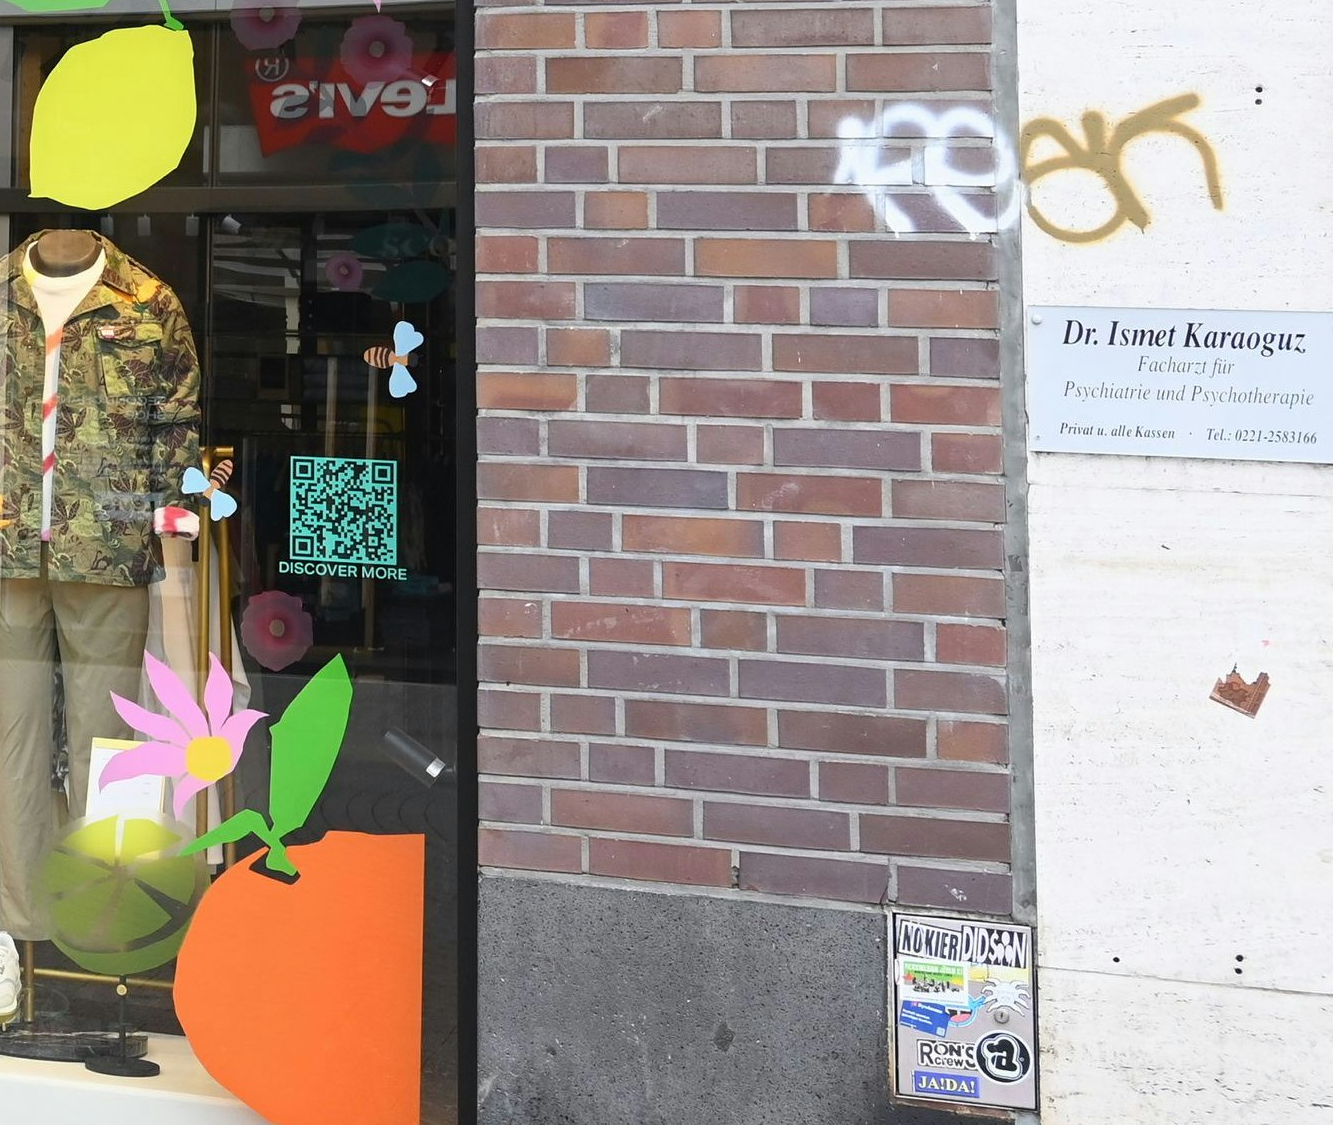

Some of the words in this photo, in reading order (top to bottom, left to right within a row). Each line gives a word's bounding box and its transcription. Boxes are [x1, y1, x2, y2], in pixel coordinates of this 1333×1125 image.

[1062, 319, 1099, 346] Dr.
[1107, 320, 1176, 348] Ismet
[1183, 322, 1307, 358] Karaoguz
[1137, 356, 1207, 375] Facharzt
[1209, 358, 1235, 378] für
[1063, 381, 1151, 403] Psychiatrie
[1156, 385, 1185, 403] und
[1191, 386, 1315, 410] Psychotherapie
[1059, 422, 1094, 437] Privat
[1097, 426, 1108, 437] u.
[1111, 424, 1132, 438] alle
[1135, 426, 1176, 440] Kassen
[1234, 428, 1318, 444] 0221-2583166
[279, 561, 358, 578] DISCOVER
[361, 565, 408, 581] MORE
[934, 1055, 963, 1067] crew
[919, 1075, 975, 1094] JA!DA!
